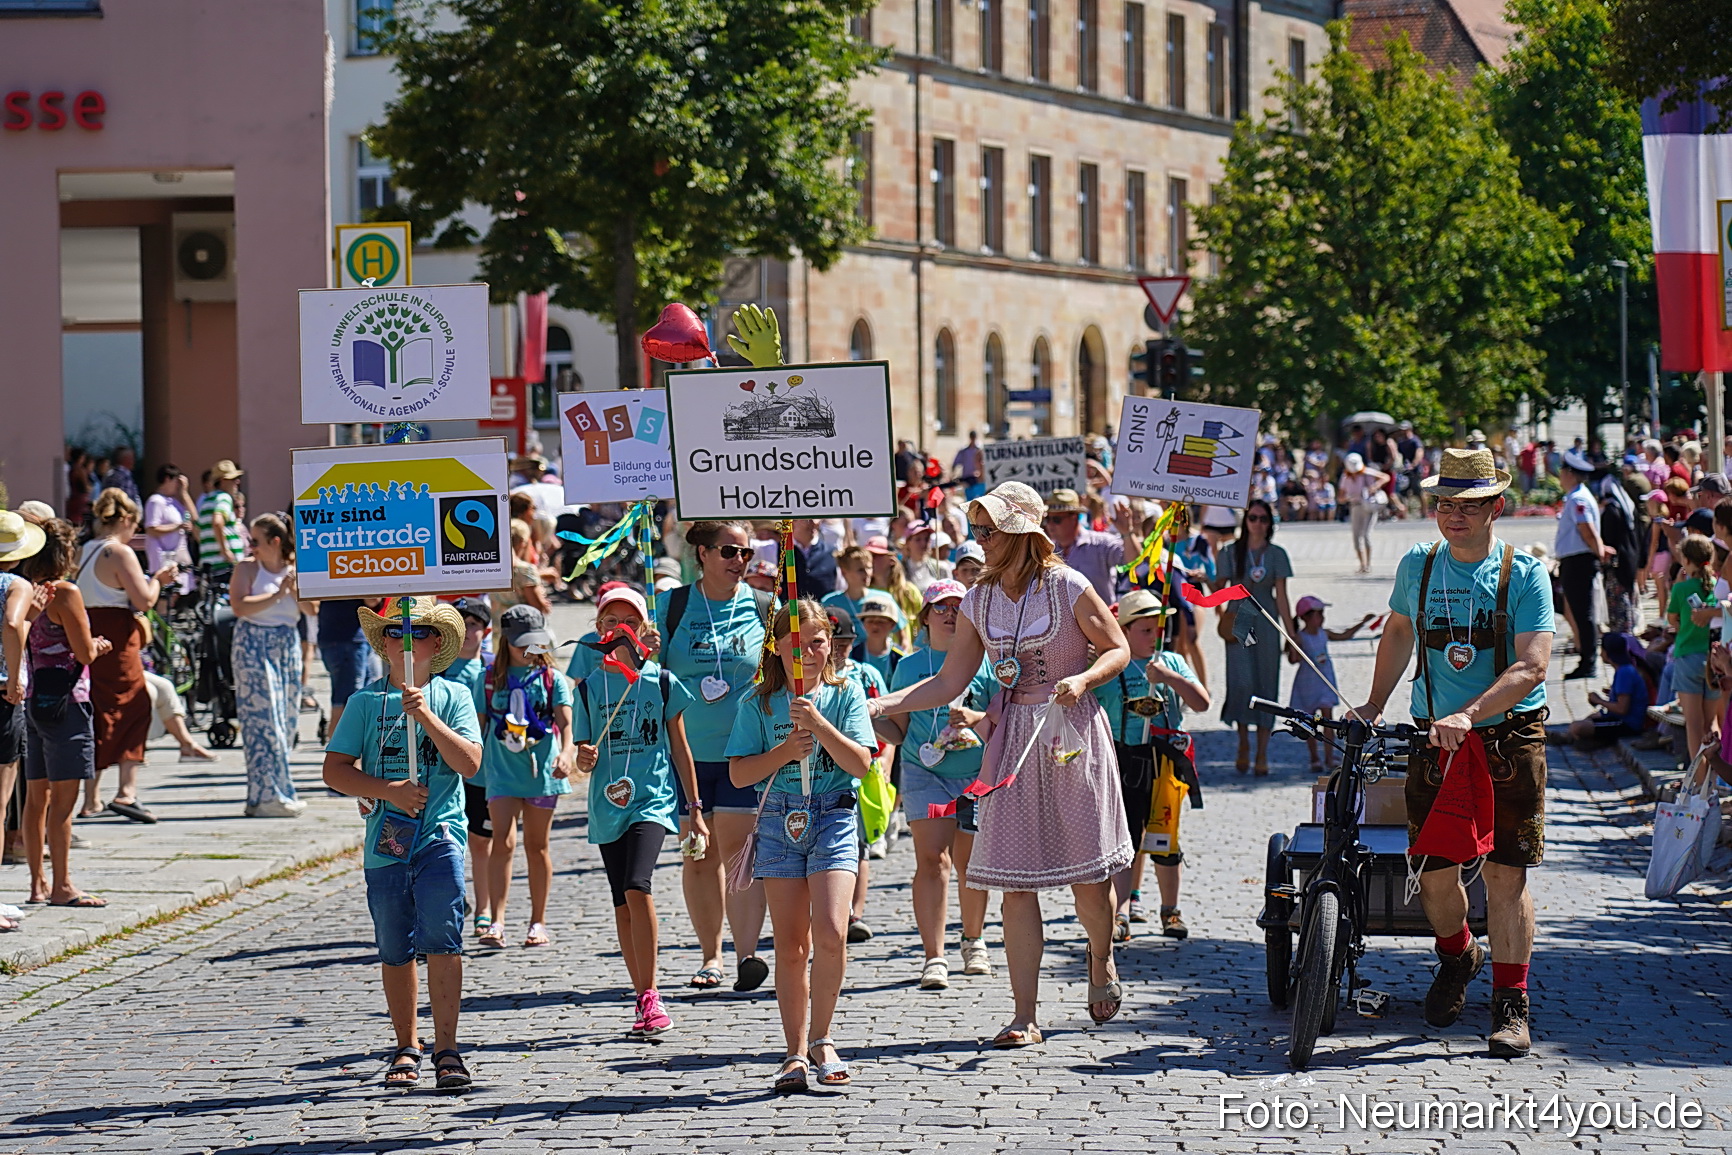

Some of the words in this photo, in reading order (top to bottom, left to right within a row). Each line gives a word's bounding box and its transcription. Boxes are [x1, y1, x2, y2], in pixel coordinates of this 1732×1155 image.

[2, 90, 107, 131] sse
[362, 246, 384, 275] H
[331, 292, 409, 347] UMWELTSCHULE
[409, 295, 424, 307] IN
[424, 302, 454, 343] EUROPA
[329, 353, 386, 415] INTERNATIONALE
[388, 398, 431, 416] AGENDA
[429, 348, 456, 400] 21-SCHULE
[1128, 404, 1148, 453] SINUS
[613, 461, 651, 471] Bildung
[654, 459, 672, 469] dur
[689, 445, 874, 473] Grundschule
[614, 473, 656, 485] Sprache
[660, 473, 672, 481] un
[1130, 480, 1146, 490] Wir
[1147, 481, 1164, 492] sind
[1171, 484, 1240, 500] SINUSSCHULE
[719, 484, 854, 510] Holzheim
[300, 509, 334, 525] Wir
[341, 506, 386, 522] sind
[300, 523, 431, 549] Fairtrade
[335, 552, 418, 575] School
[444, 551, 497, 562] FAIRTRADE
[1429, 596, 1460, 604] Holzeim
